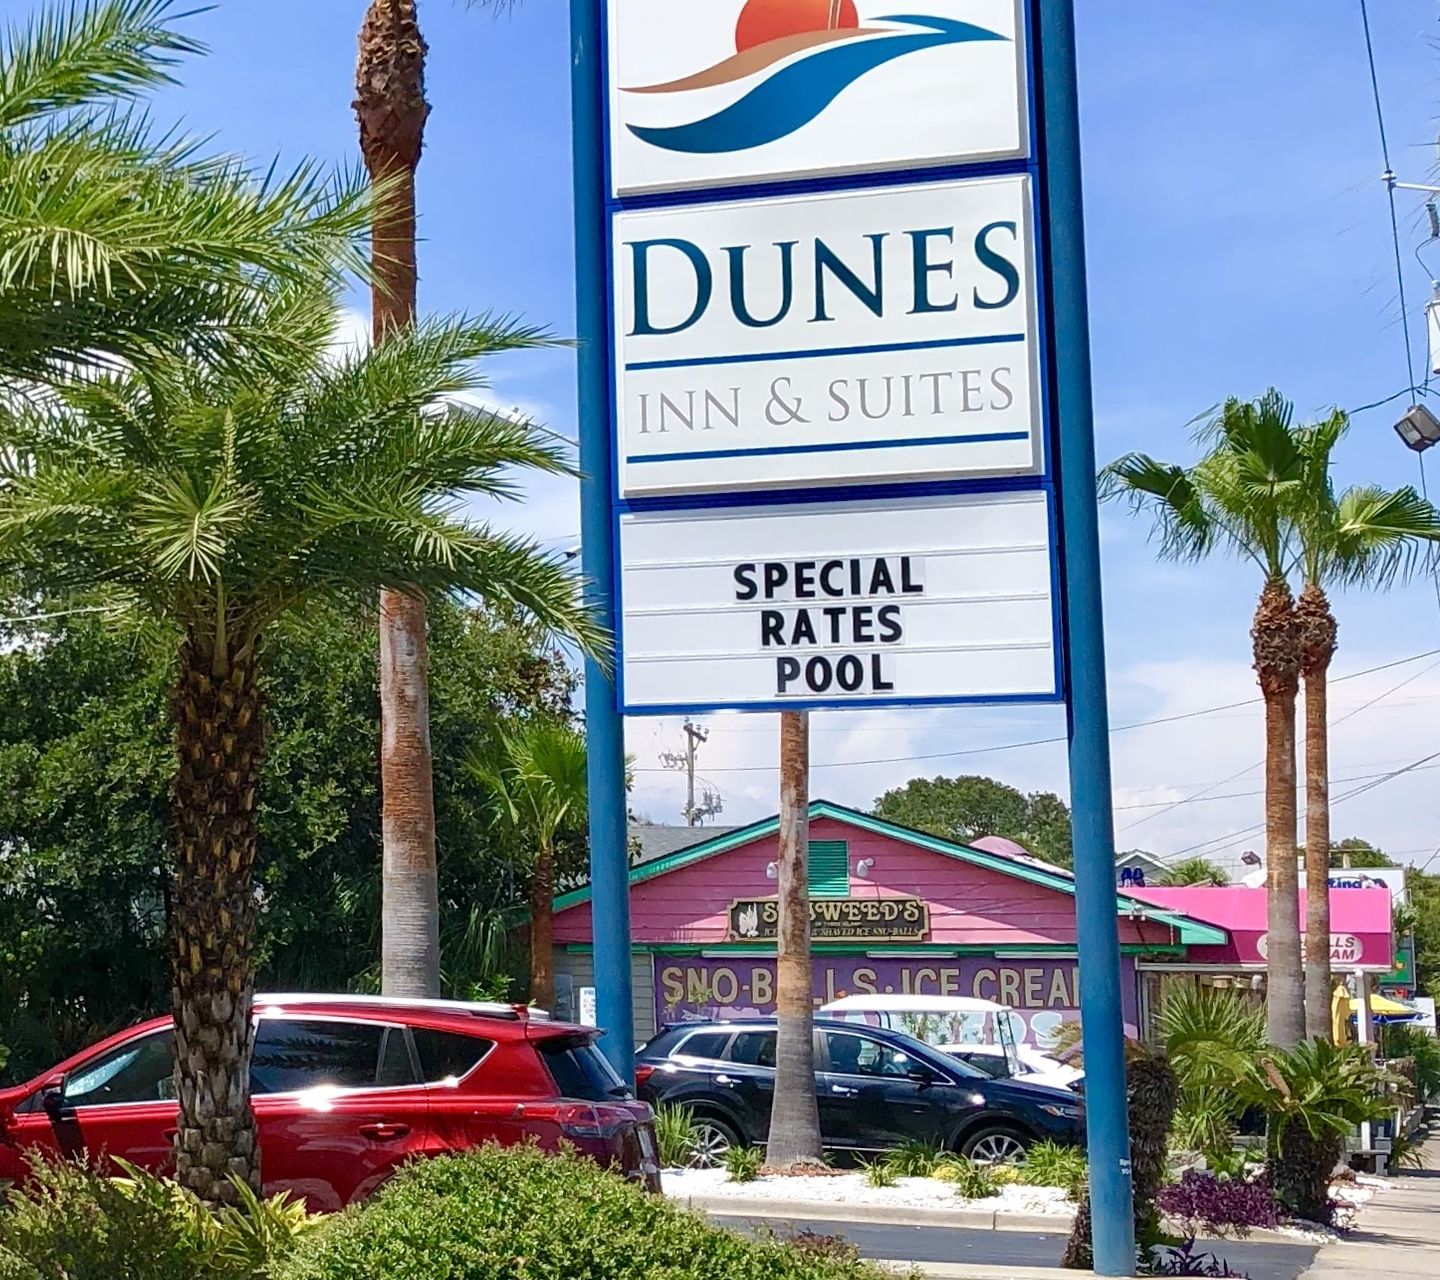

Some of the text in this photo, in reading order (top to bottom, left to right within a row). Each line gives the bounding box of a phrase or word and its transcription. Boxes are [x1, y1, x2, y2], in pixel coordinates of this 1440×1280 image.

[622, 221, 1020, 337] DUNES
[638, 367, 1014, 435] INN & SUITES
[734, 556, 924, 601] SPECIAL
[761, 605, 902, 646] RATES
[777, 653, 894, 693] POOL
[762, 902, 920, 923] SWEED'S
[972, 968, 1080, 1008] CREA
